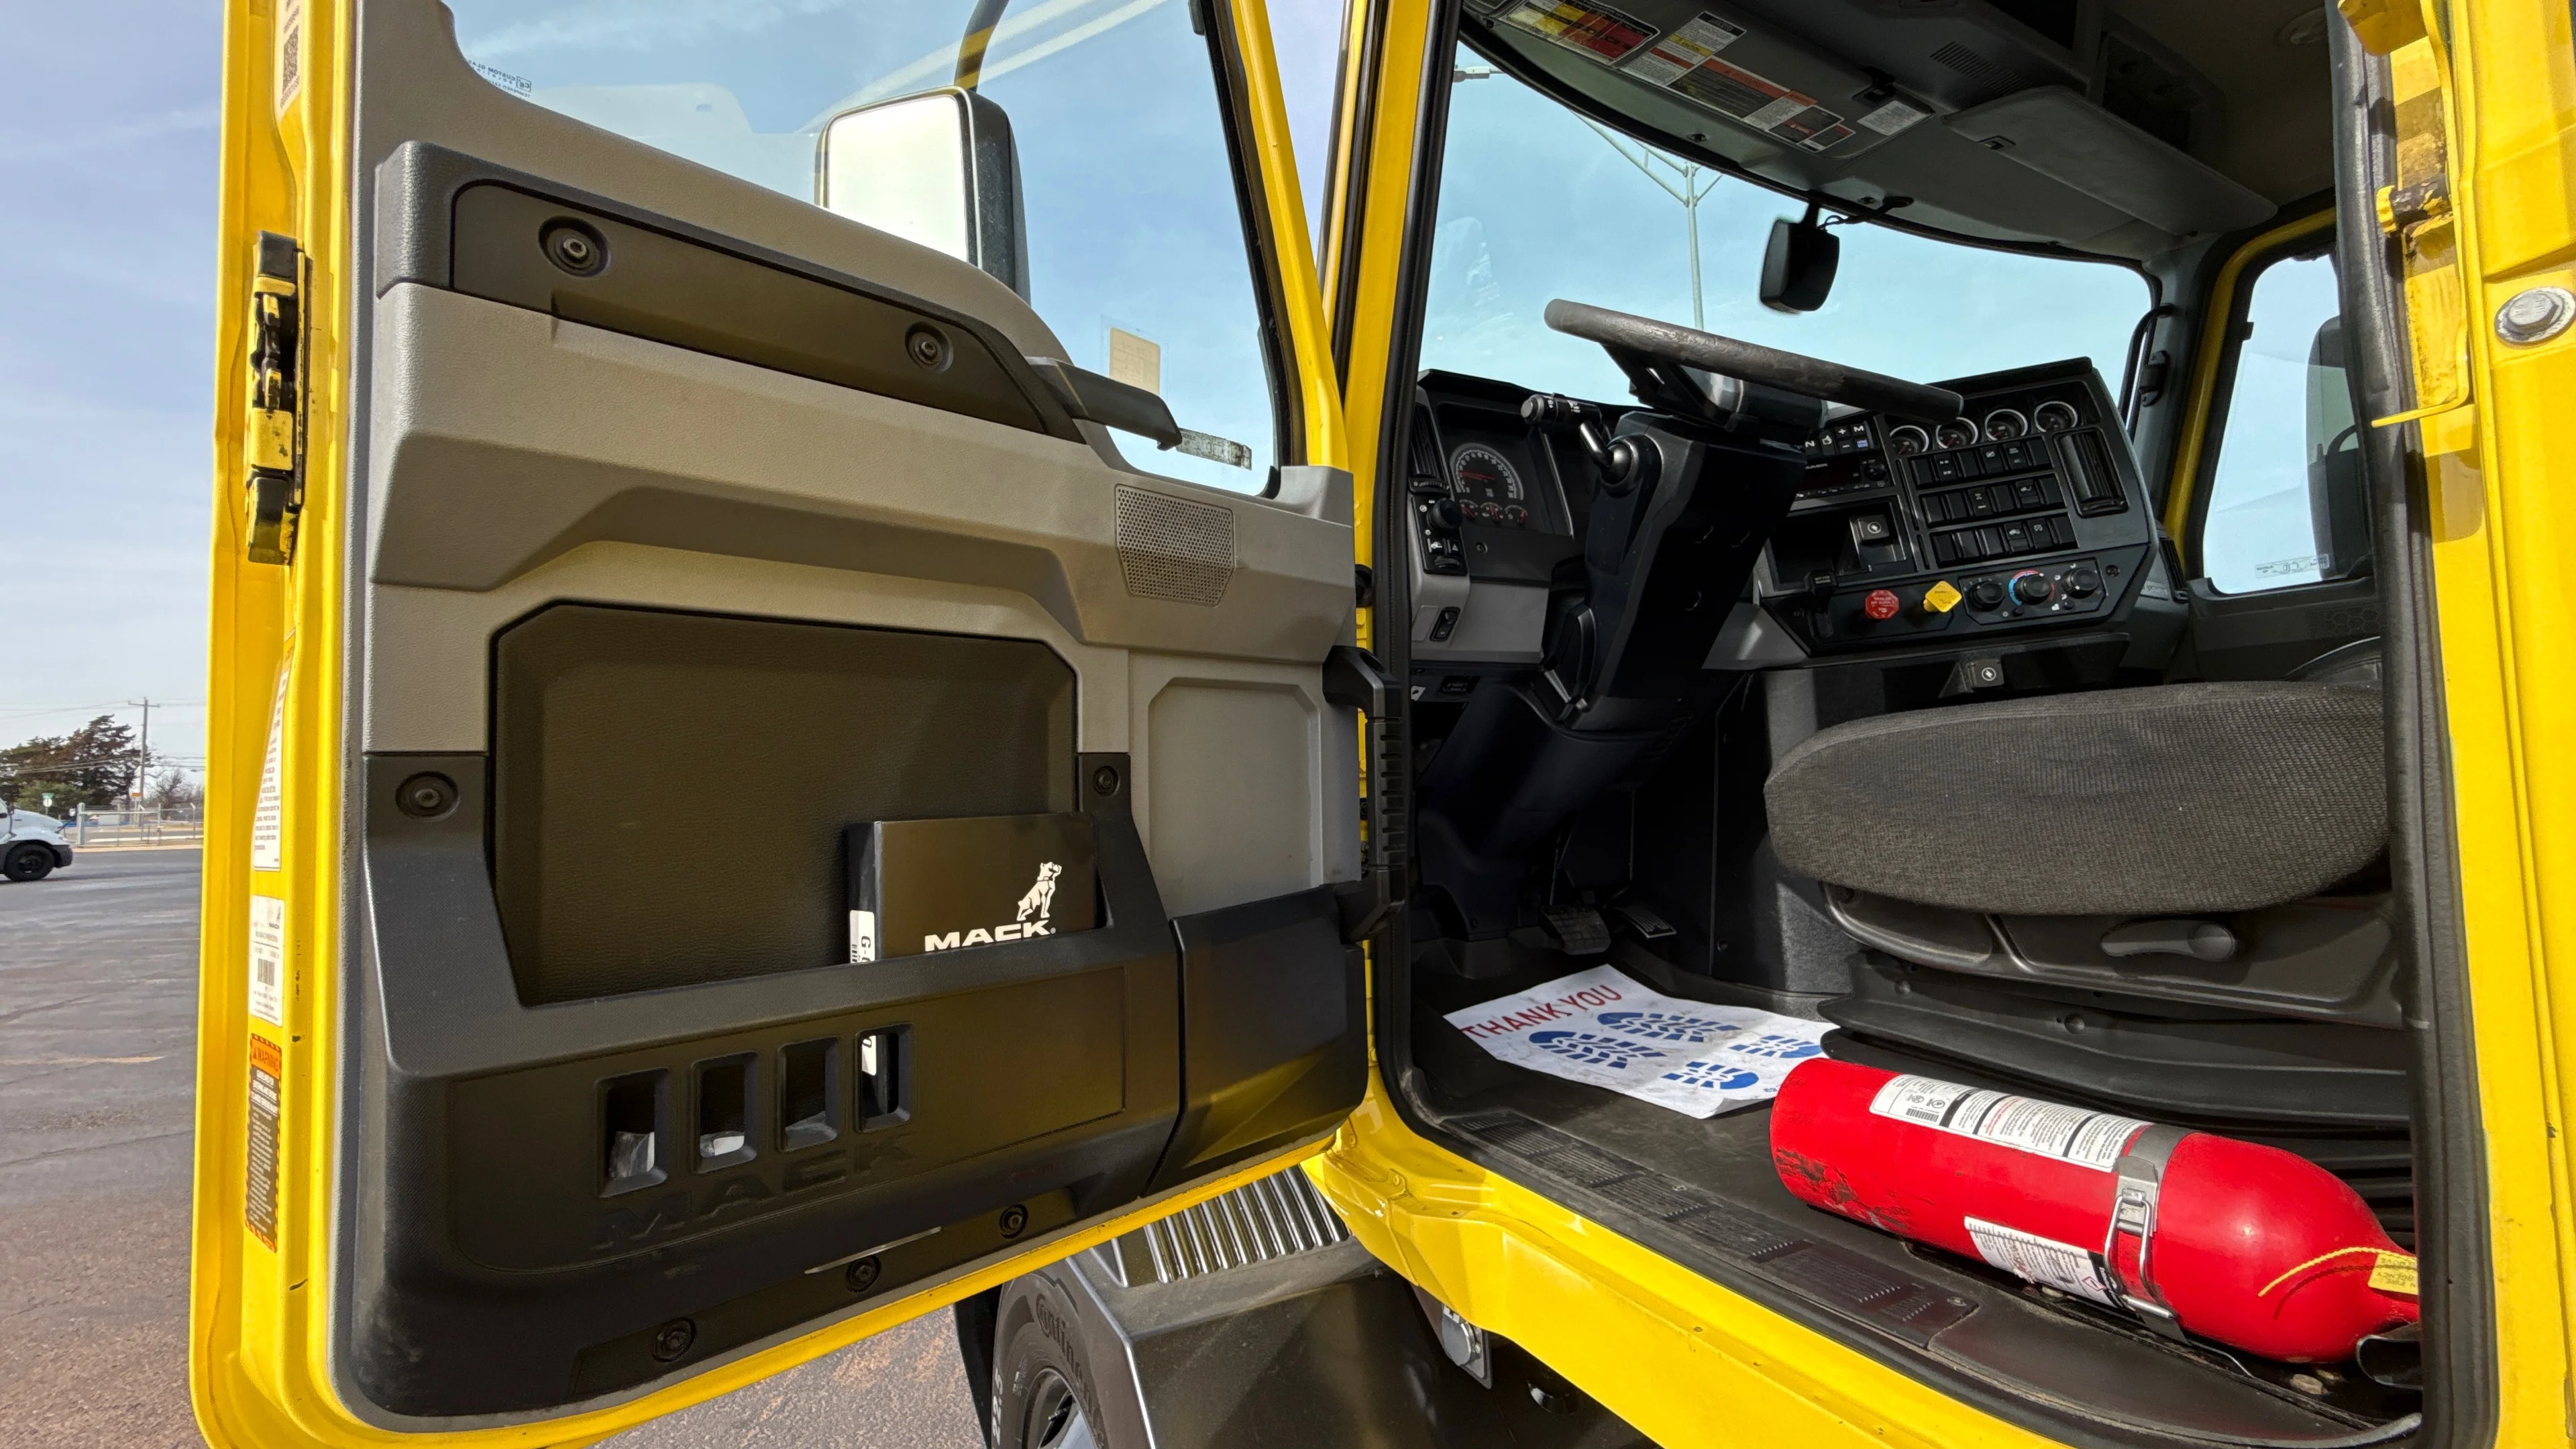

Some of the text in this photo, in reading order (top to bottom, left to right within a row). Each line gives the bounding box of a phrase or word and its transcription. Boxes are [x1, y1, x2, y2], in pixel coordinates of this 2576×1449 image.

[925, 920, 1051, 952] MACK
[1460, 984, 1623, 1039] THANK YOU
[590, 1131, 915, 1252] MACK
